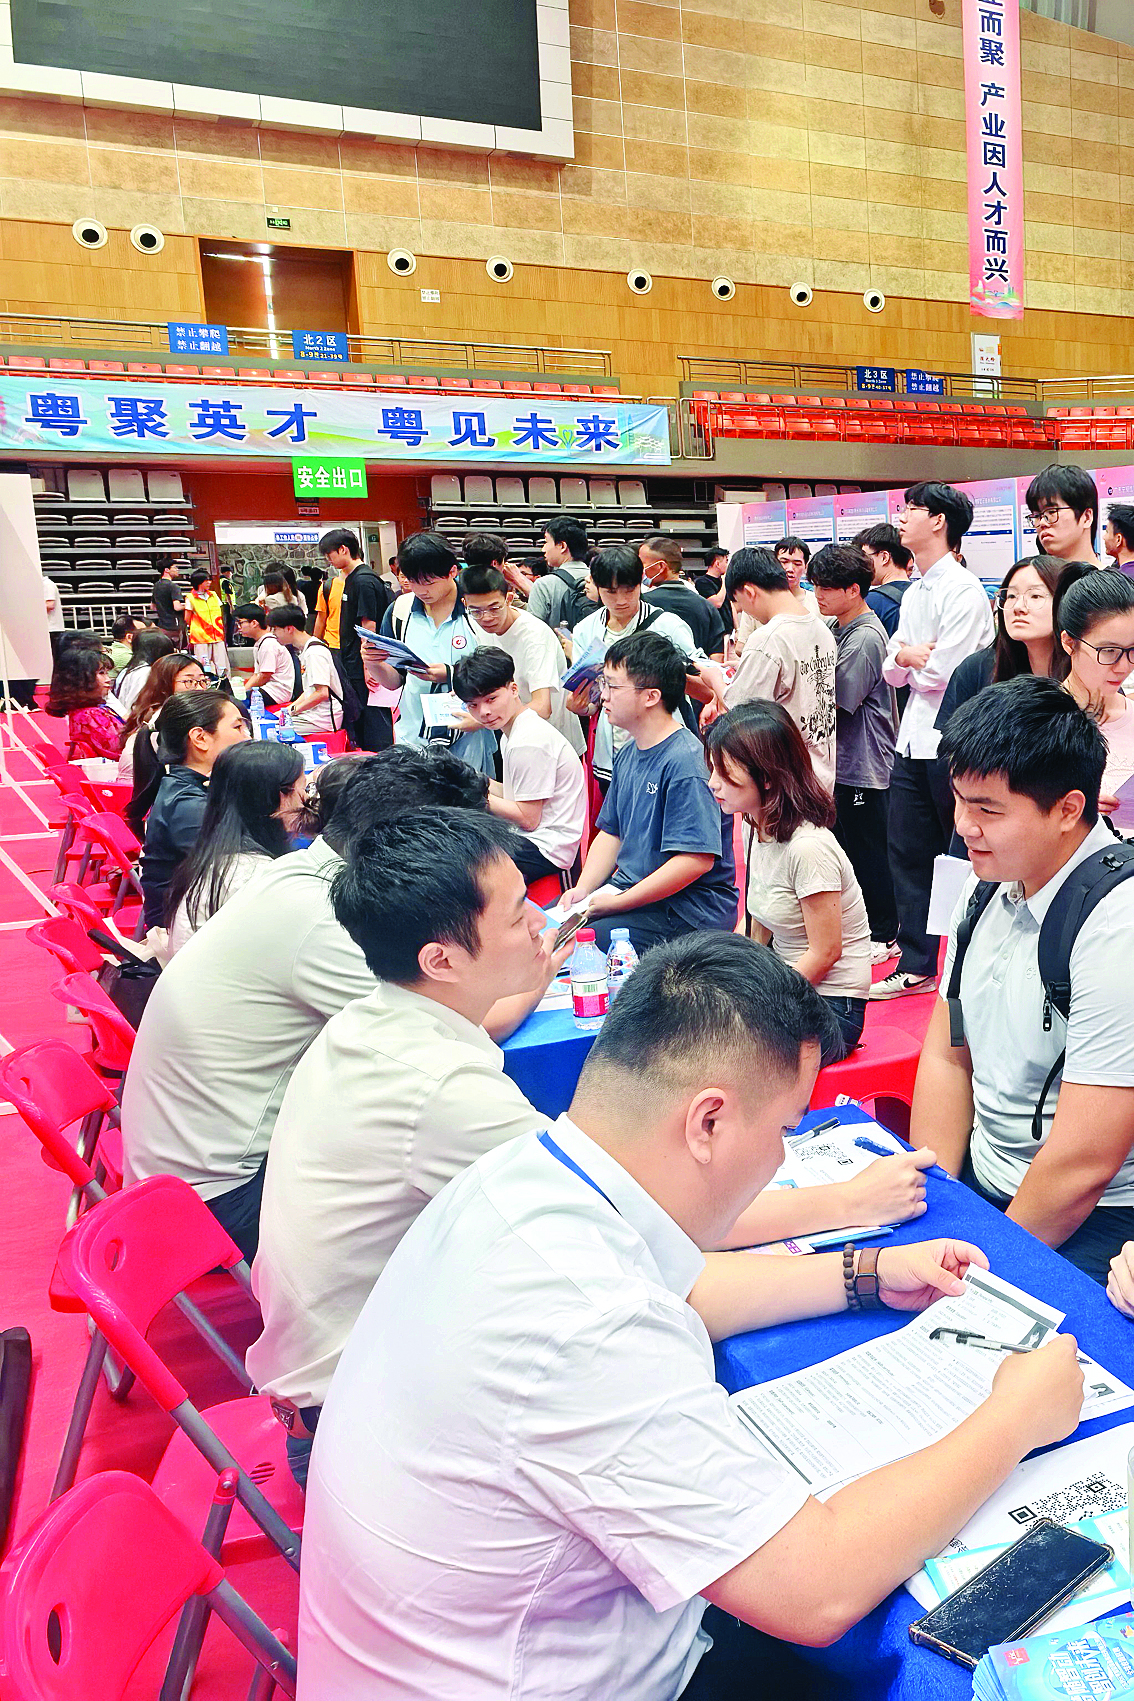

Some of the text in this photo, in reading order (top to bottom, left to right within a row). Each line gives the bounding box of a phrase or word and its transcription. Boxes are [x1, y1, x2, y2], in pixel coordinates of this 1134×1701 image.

[980, 83, 1009, 283] 产业因人才而兴
[176, 326, 221, 339] 禁止攀爬
[176, 339, 222, 352] 禁止翻越
[303, 333, 337, 347] 北2区
[864, 368, 888, 380] 北3区
[25, 392, 622, 452] 粤聚英才 粤见未来
[297, 466, 363, 489] 安全出口
